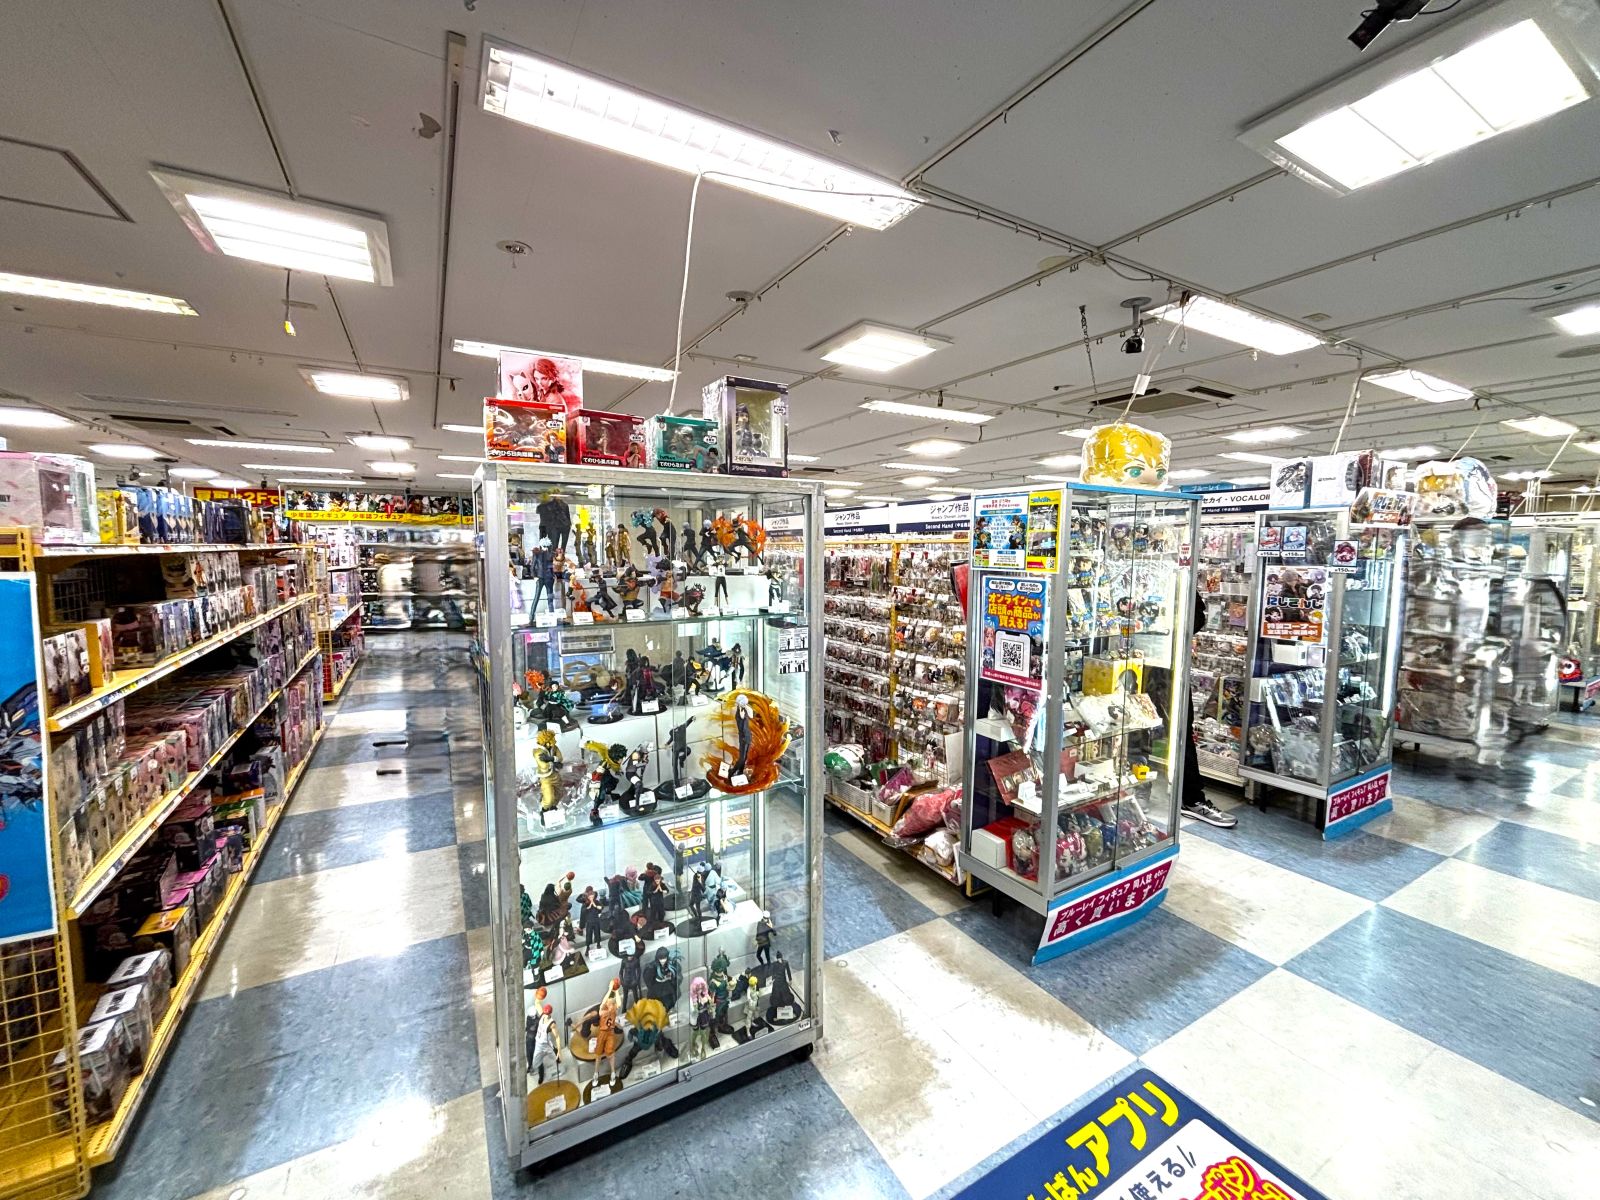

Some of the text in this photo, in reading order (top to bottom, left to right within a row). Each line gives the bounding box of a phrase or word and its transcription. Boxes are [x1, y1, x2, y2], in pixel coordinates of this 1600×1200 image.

[290, 511, 347, 519] 少年誌フィギュア
[930, 502, 969, 514] ジャンプ作品
[835, 511, 861, 521] ジャンプ作品
[988, 593, 1042, 607] オンラインでも
[1266, 596, 1324, 610] にじさんじ
[988, 603, 1041, 620] 店頭の商品が
[999, 616, 1028, 630] 買える!
[1060, 897, 1096, 921] ブルーレイ
[1098, 883, 1131, 905] フィギュア
[1132, 873, 1153, 890] 同人誌
[1053, 876, 1166, 937] 高く買います!!
[606, 1018, 612, 1026] 6
[1117, 1157, 1187, 1200] 使える
